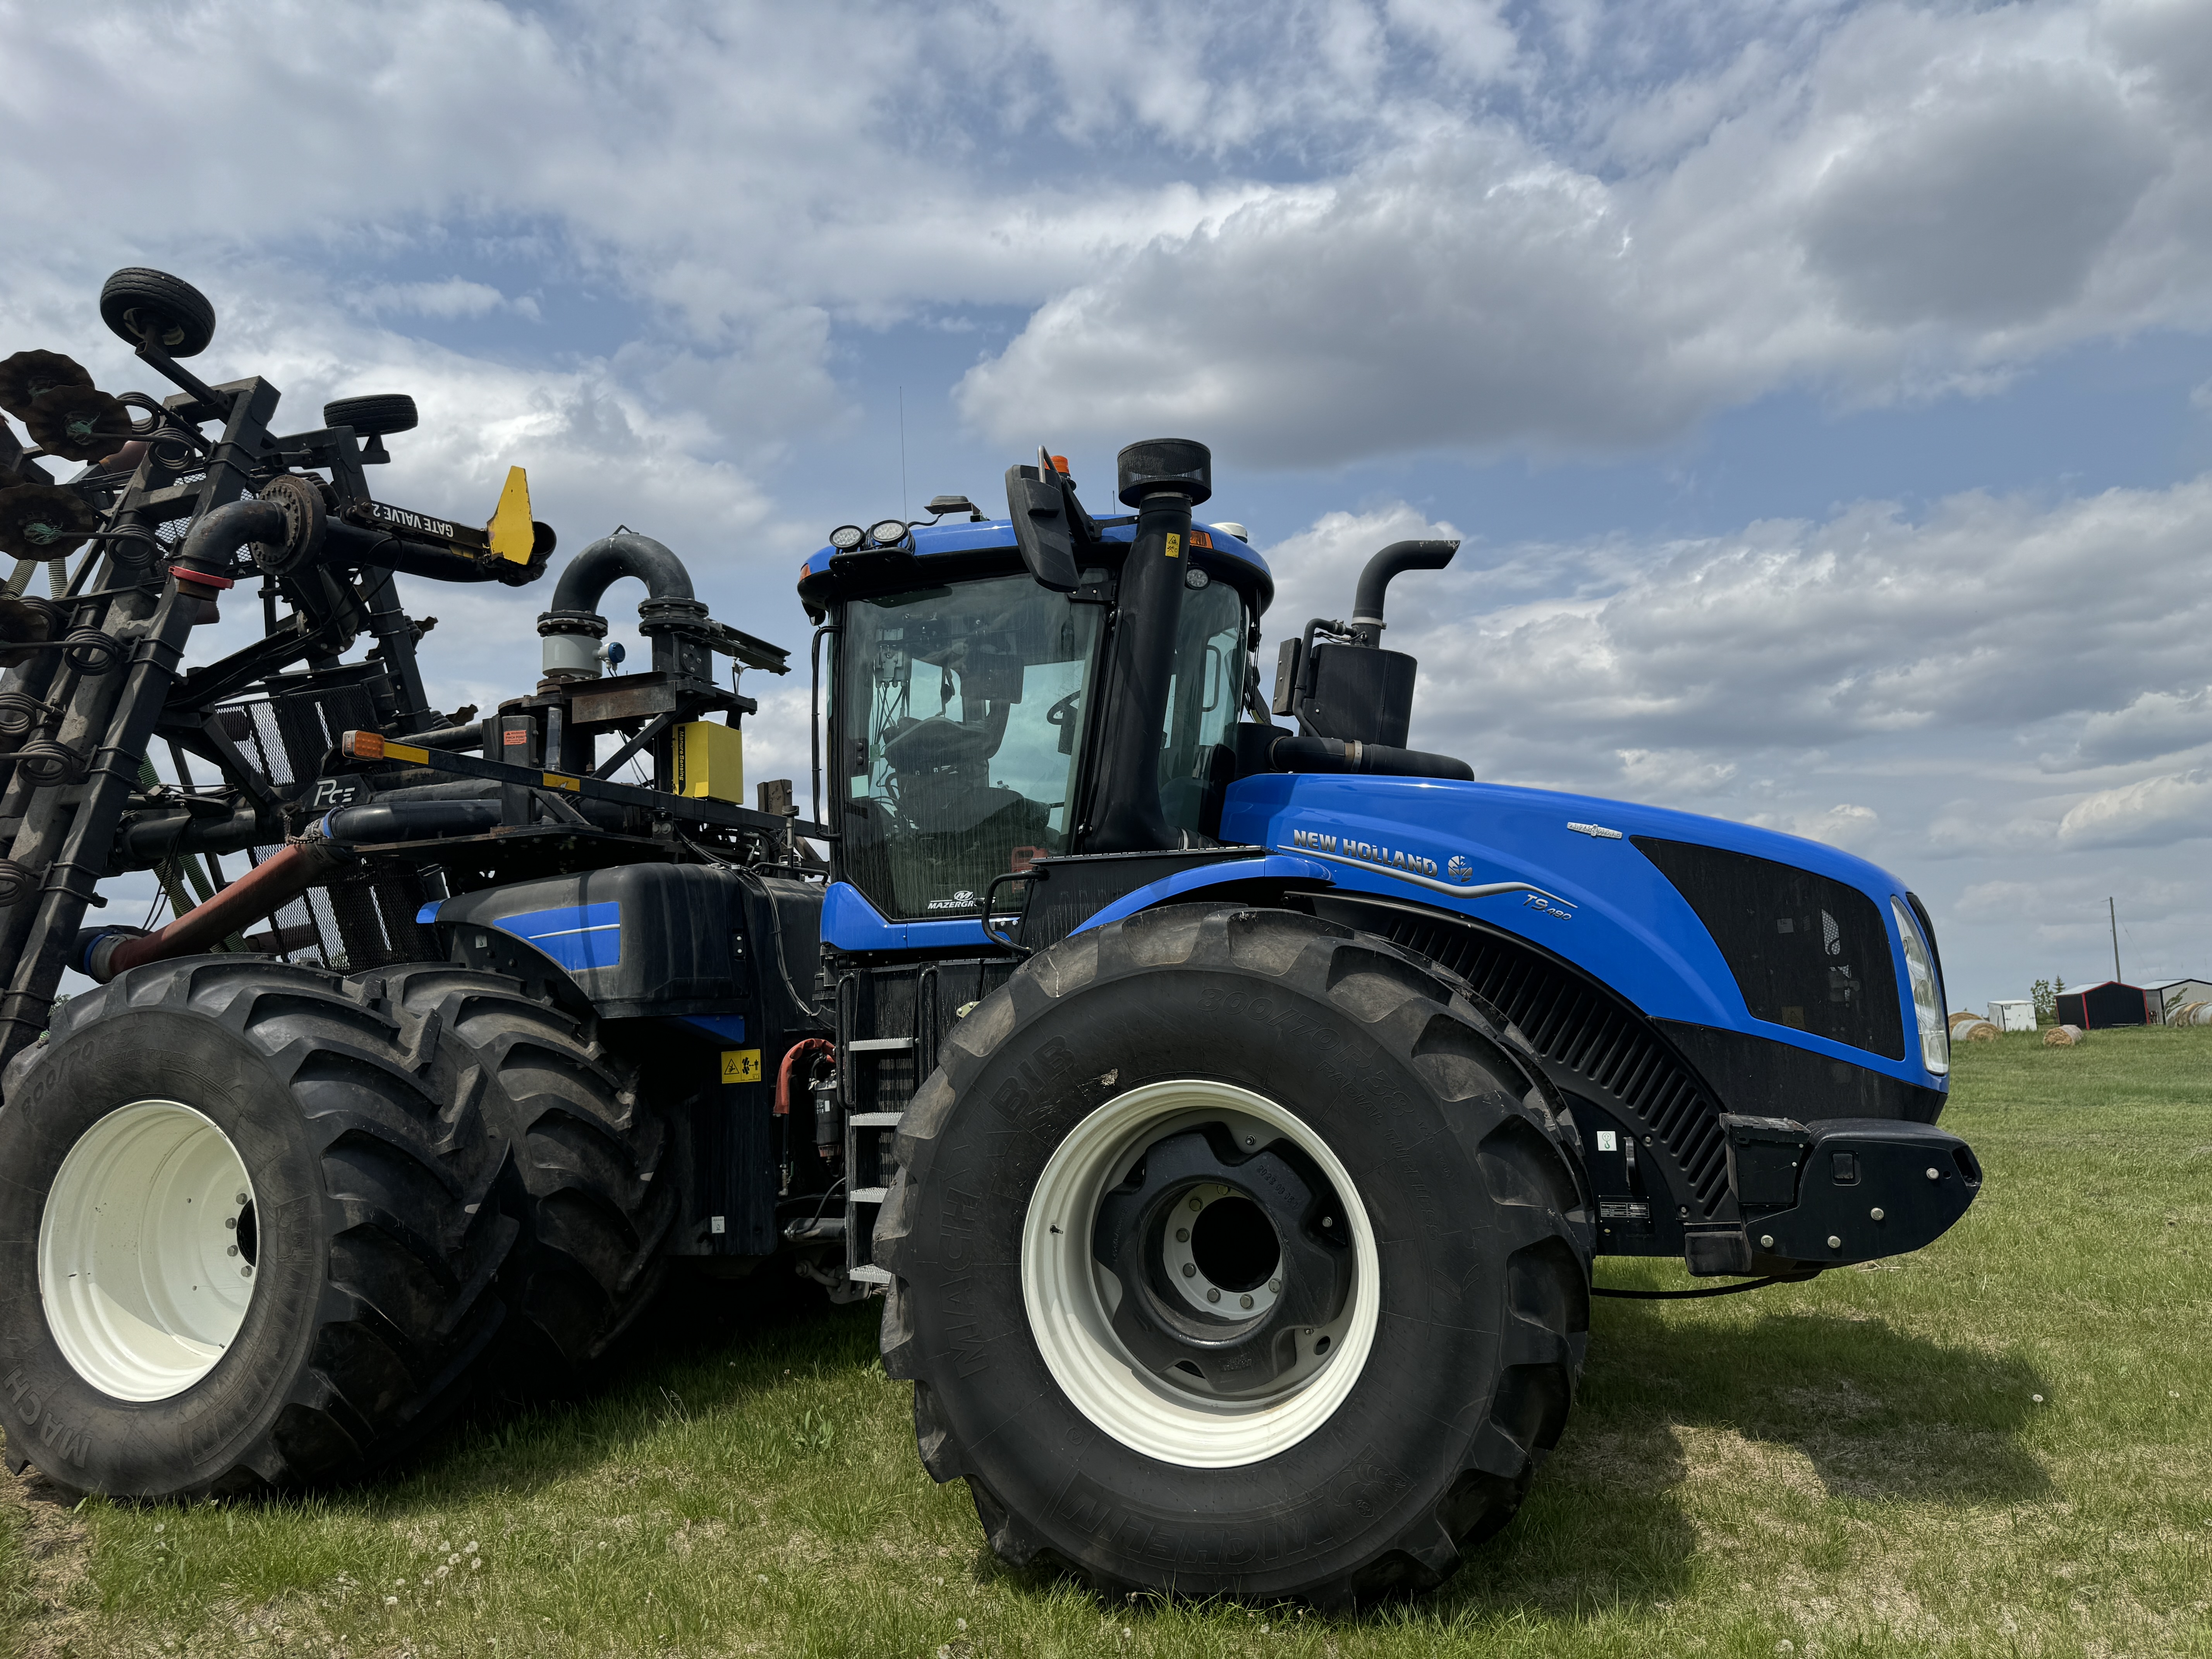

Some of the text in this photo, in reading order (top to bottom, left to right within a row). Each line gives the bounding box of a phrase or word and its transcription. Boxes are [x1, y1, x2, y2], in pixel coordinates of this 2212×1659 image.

[371, 503, 453, 538] GATE VALVE 2
[1294, 829, 1438, 877] NEW HOLLAND
[928, 899, 996, 909] MAZERGR
[1197, 988, 1340, 1050] 800/70
[148, 1048, 210, 1075] TUBELESS
[1316, 1060, 1384, 1125] RADIAL
[3, 1365, 92, 1468] MACH
[1060, 1492, 1334, 1565] MICHELIN
